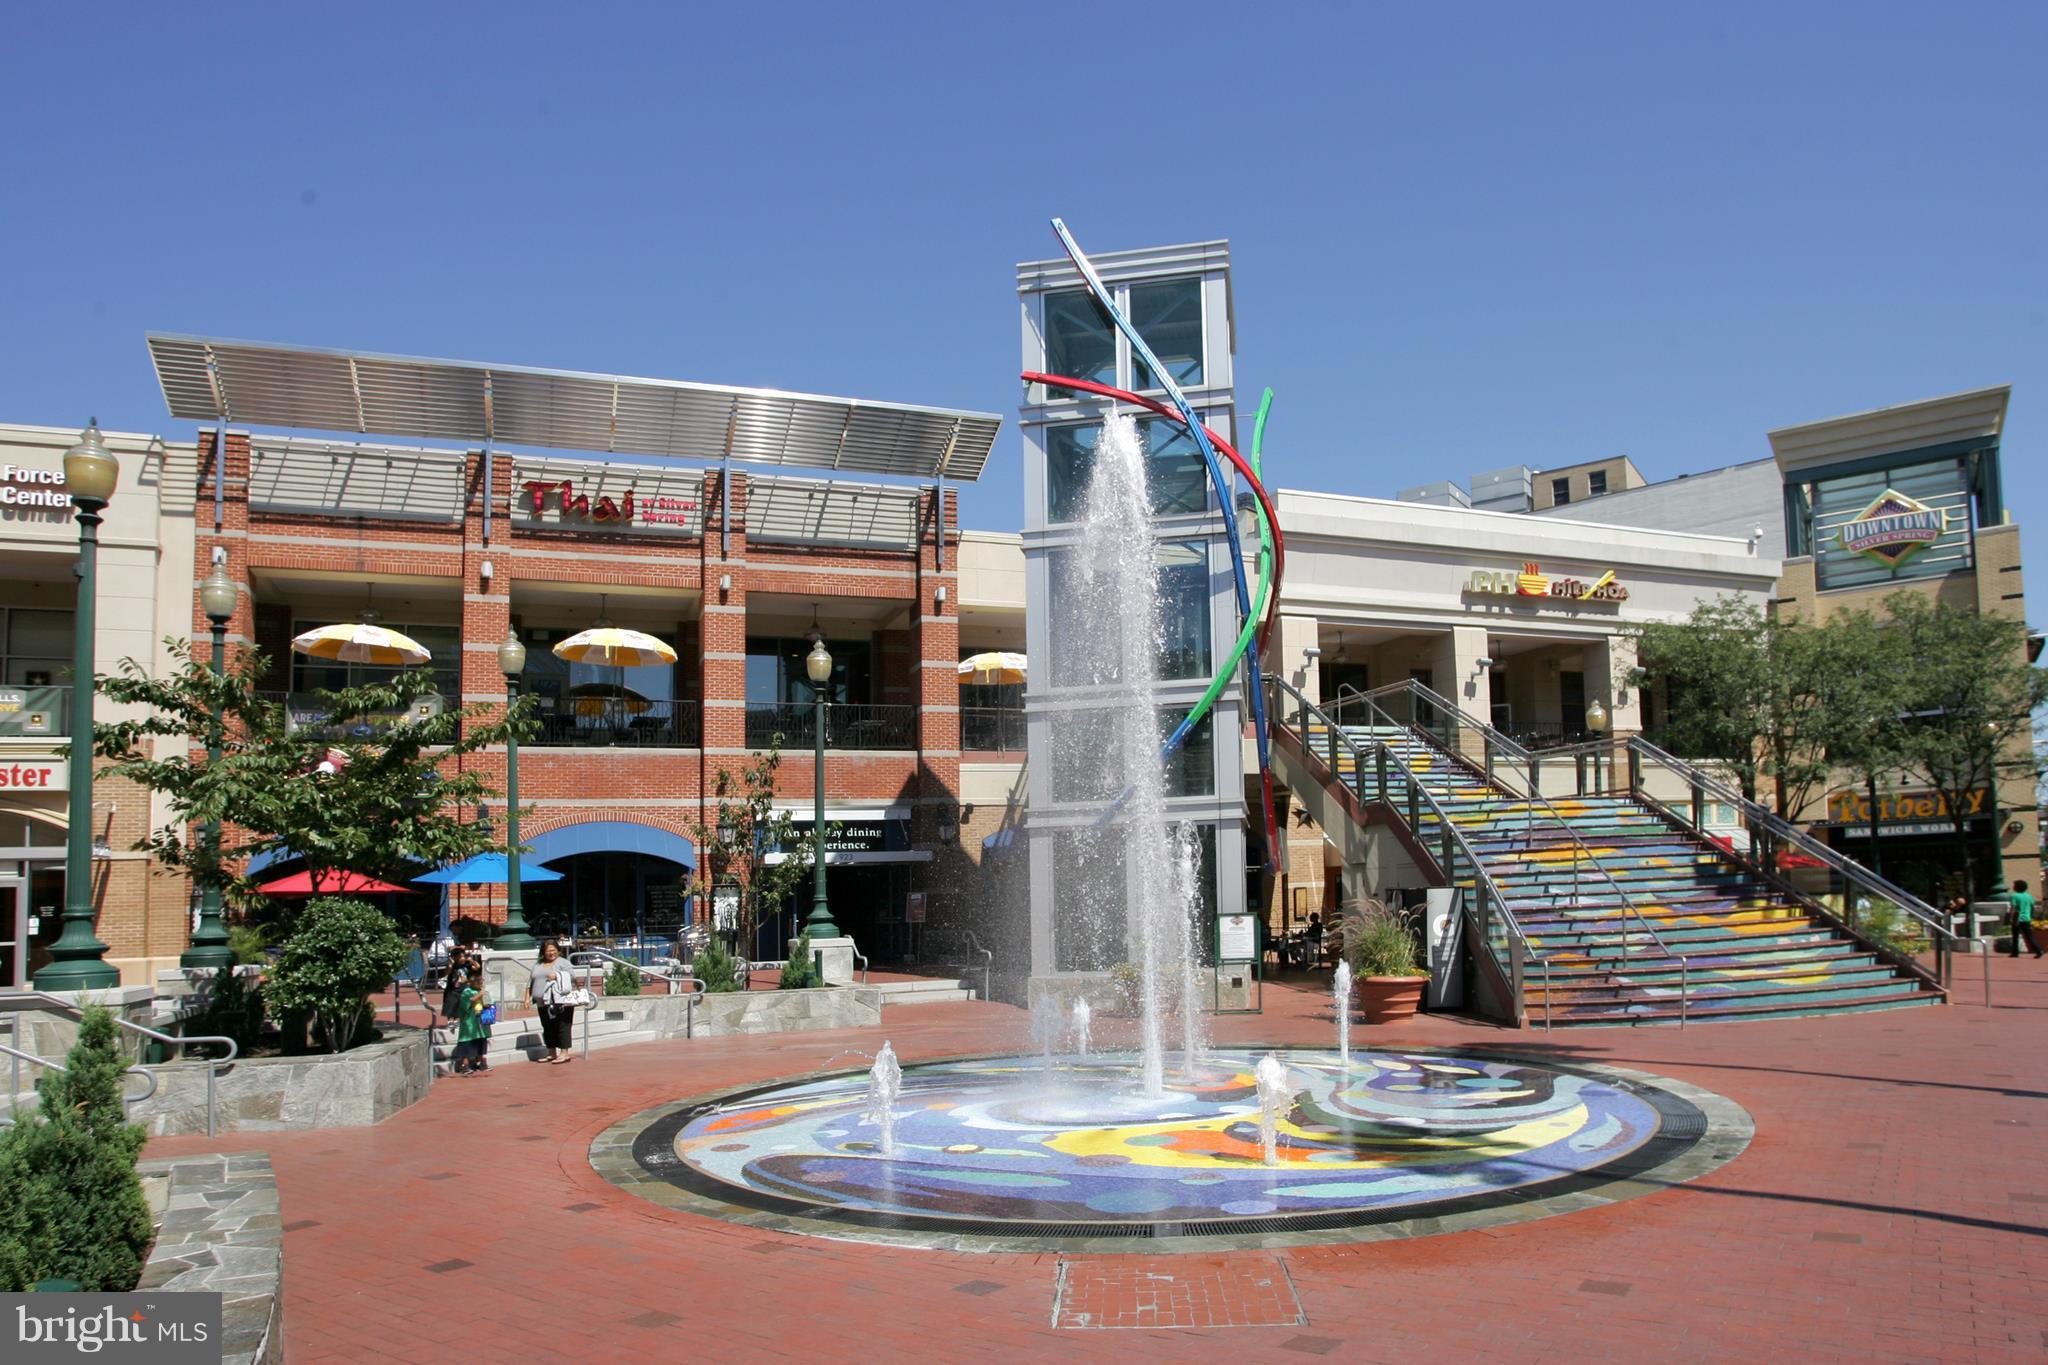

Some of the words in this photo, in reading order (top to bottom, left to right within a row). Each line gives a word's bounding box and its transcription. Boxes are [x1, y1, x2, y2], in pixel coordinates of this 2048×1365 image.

[4, 464, 65, 485] Force
[2, 486, 73, 508] Center
[521, 479, 635, 522] Thai
[1843, 511, 1941, 542] DOWNTOWN
[1854, 535, 1889, 549] SILVER
[1890, 530, 1931, 541] SPRING
[0, 764, 52, 787] ster
[783, 827, 800, 837] An
[846, 827, 882, 838] dining
[1849, 825, 1914, 837] SANWICH
[839, 853, 854, 861] 923
